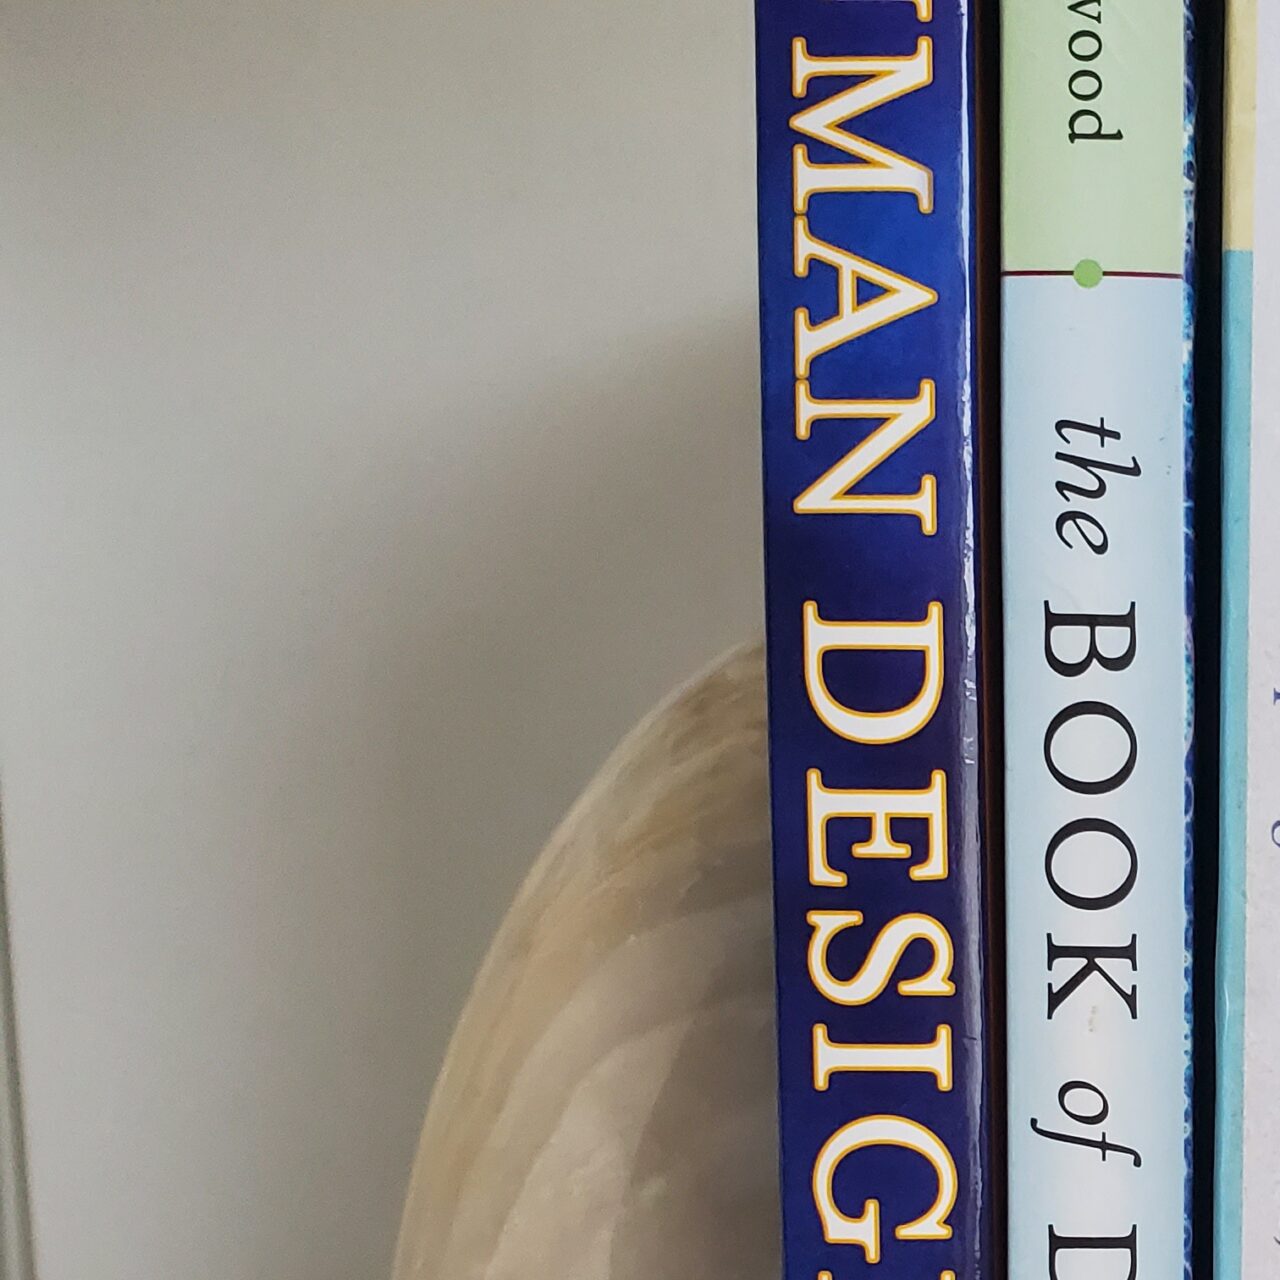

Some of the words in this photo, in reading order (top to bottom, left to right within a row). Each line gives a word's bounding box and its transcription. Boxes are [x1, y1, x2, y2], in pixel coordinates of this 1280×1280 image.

[789, 0, 939, 536] MAN
[1054, 416, 1142, 556] the
[1042, 599, 1139, 1021] BOOK
[1029, 1080, 1142, 1169] of
